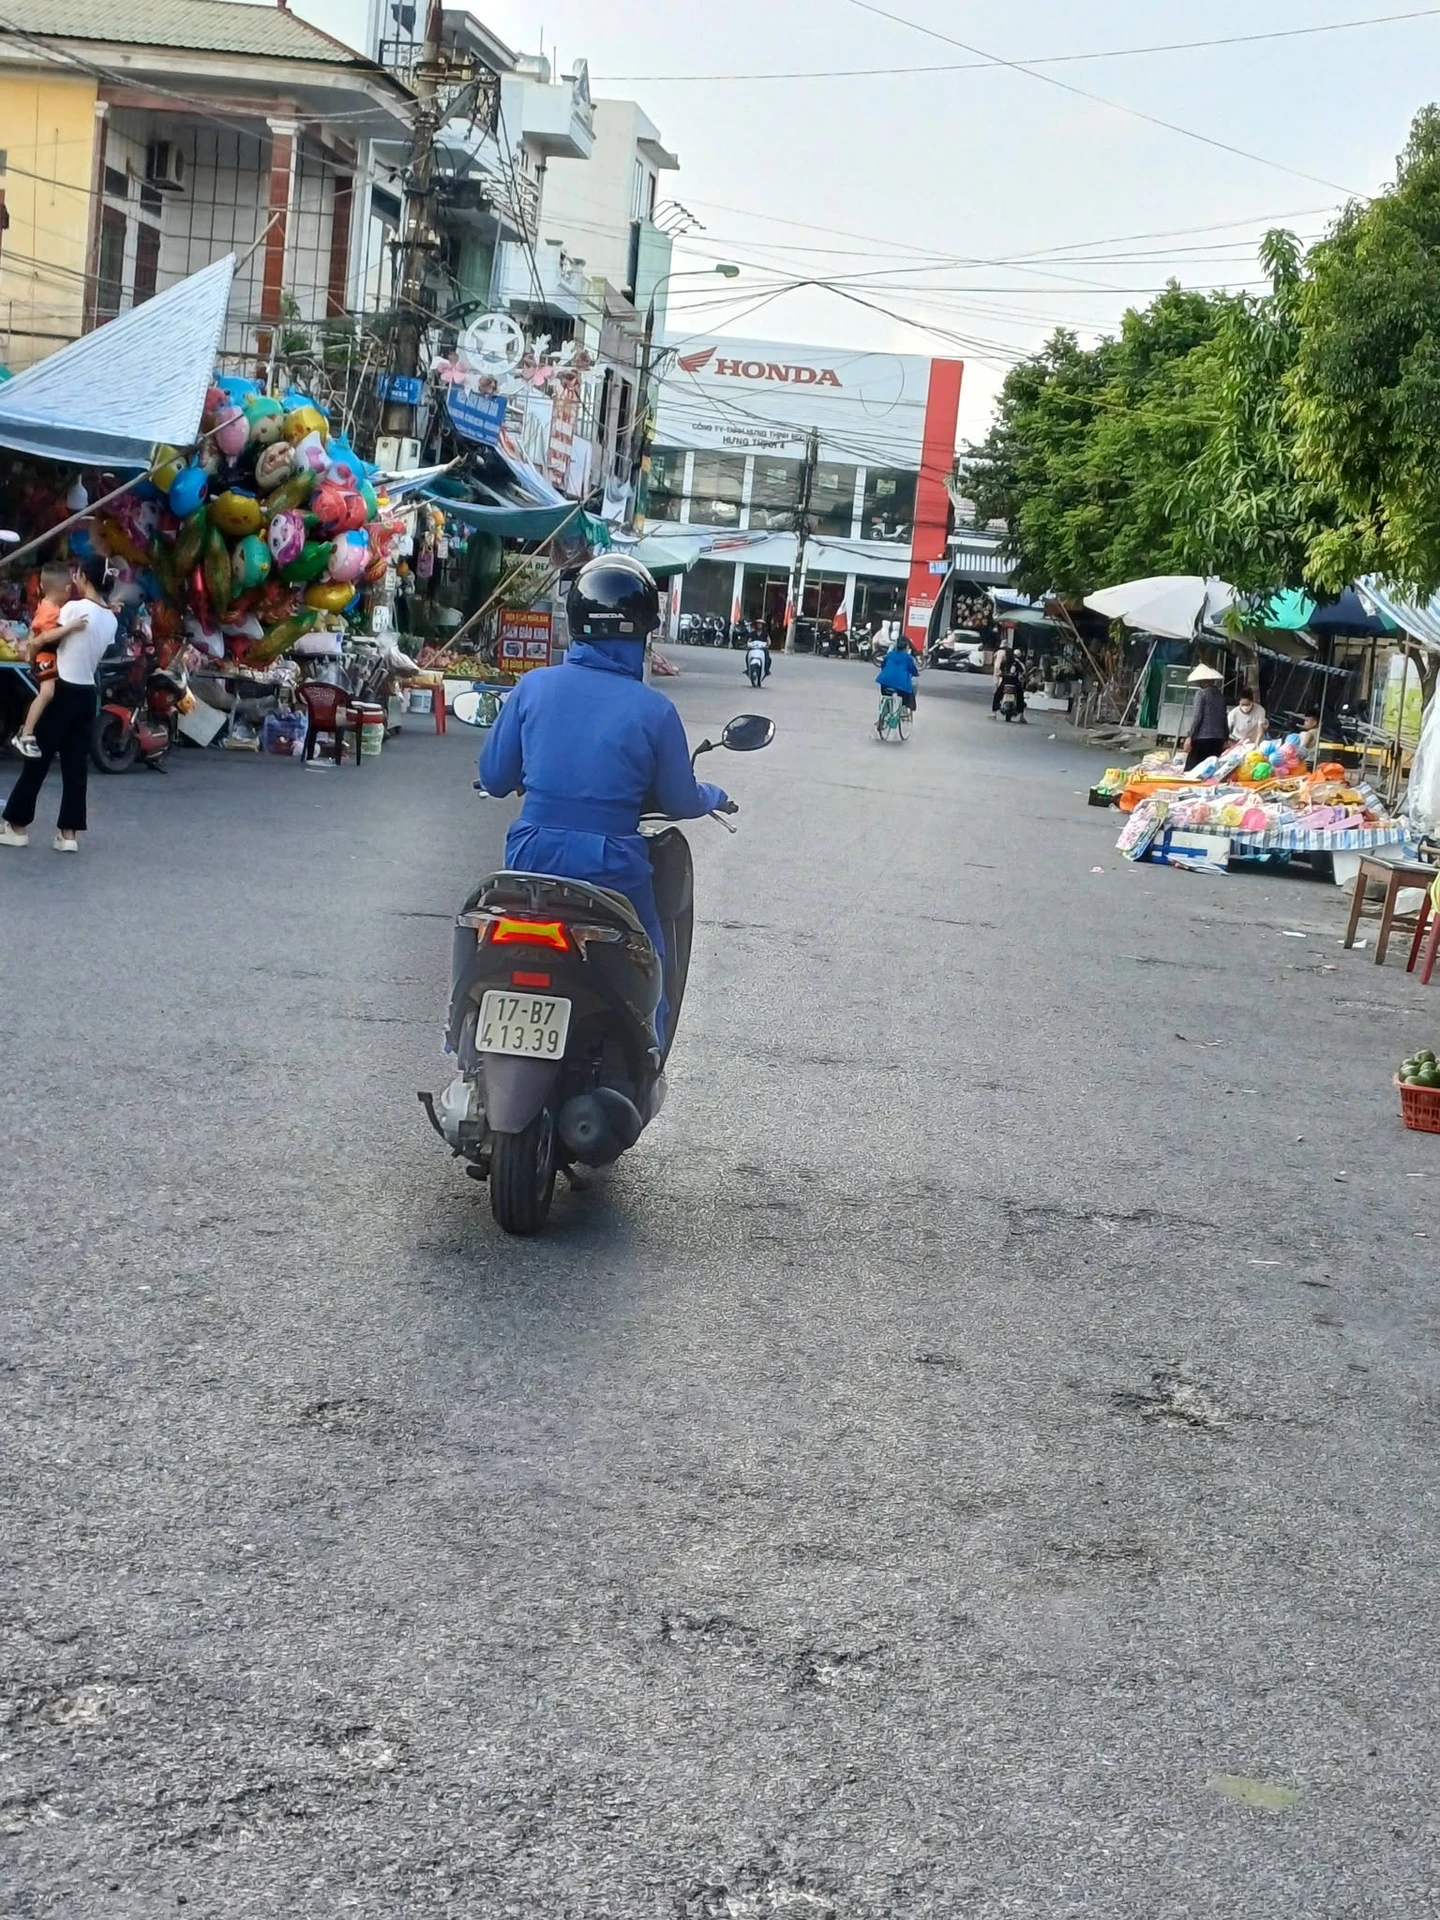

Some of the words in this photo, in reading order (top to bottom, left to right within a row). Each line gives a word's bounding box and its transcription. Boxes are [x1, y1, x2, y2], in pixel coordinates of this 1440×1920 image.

[714, 358, 843, 387] HONDA
[692, 422, 713, 432] CÔNG
[722, 436, 749, 447] HƯNG
[498, 998, 556, 1025] 17-B7
[481, 1023, 559, 1053] 413.39
